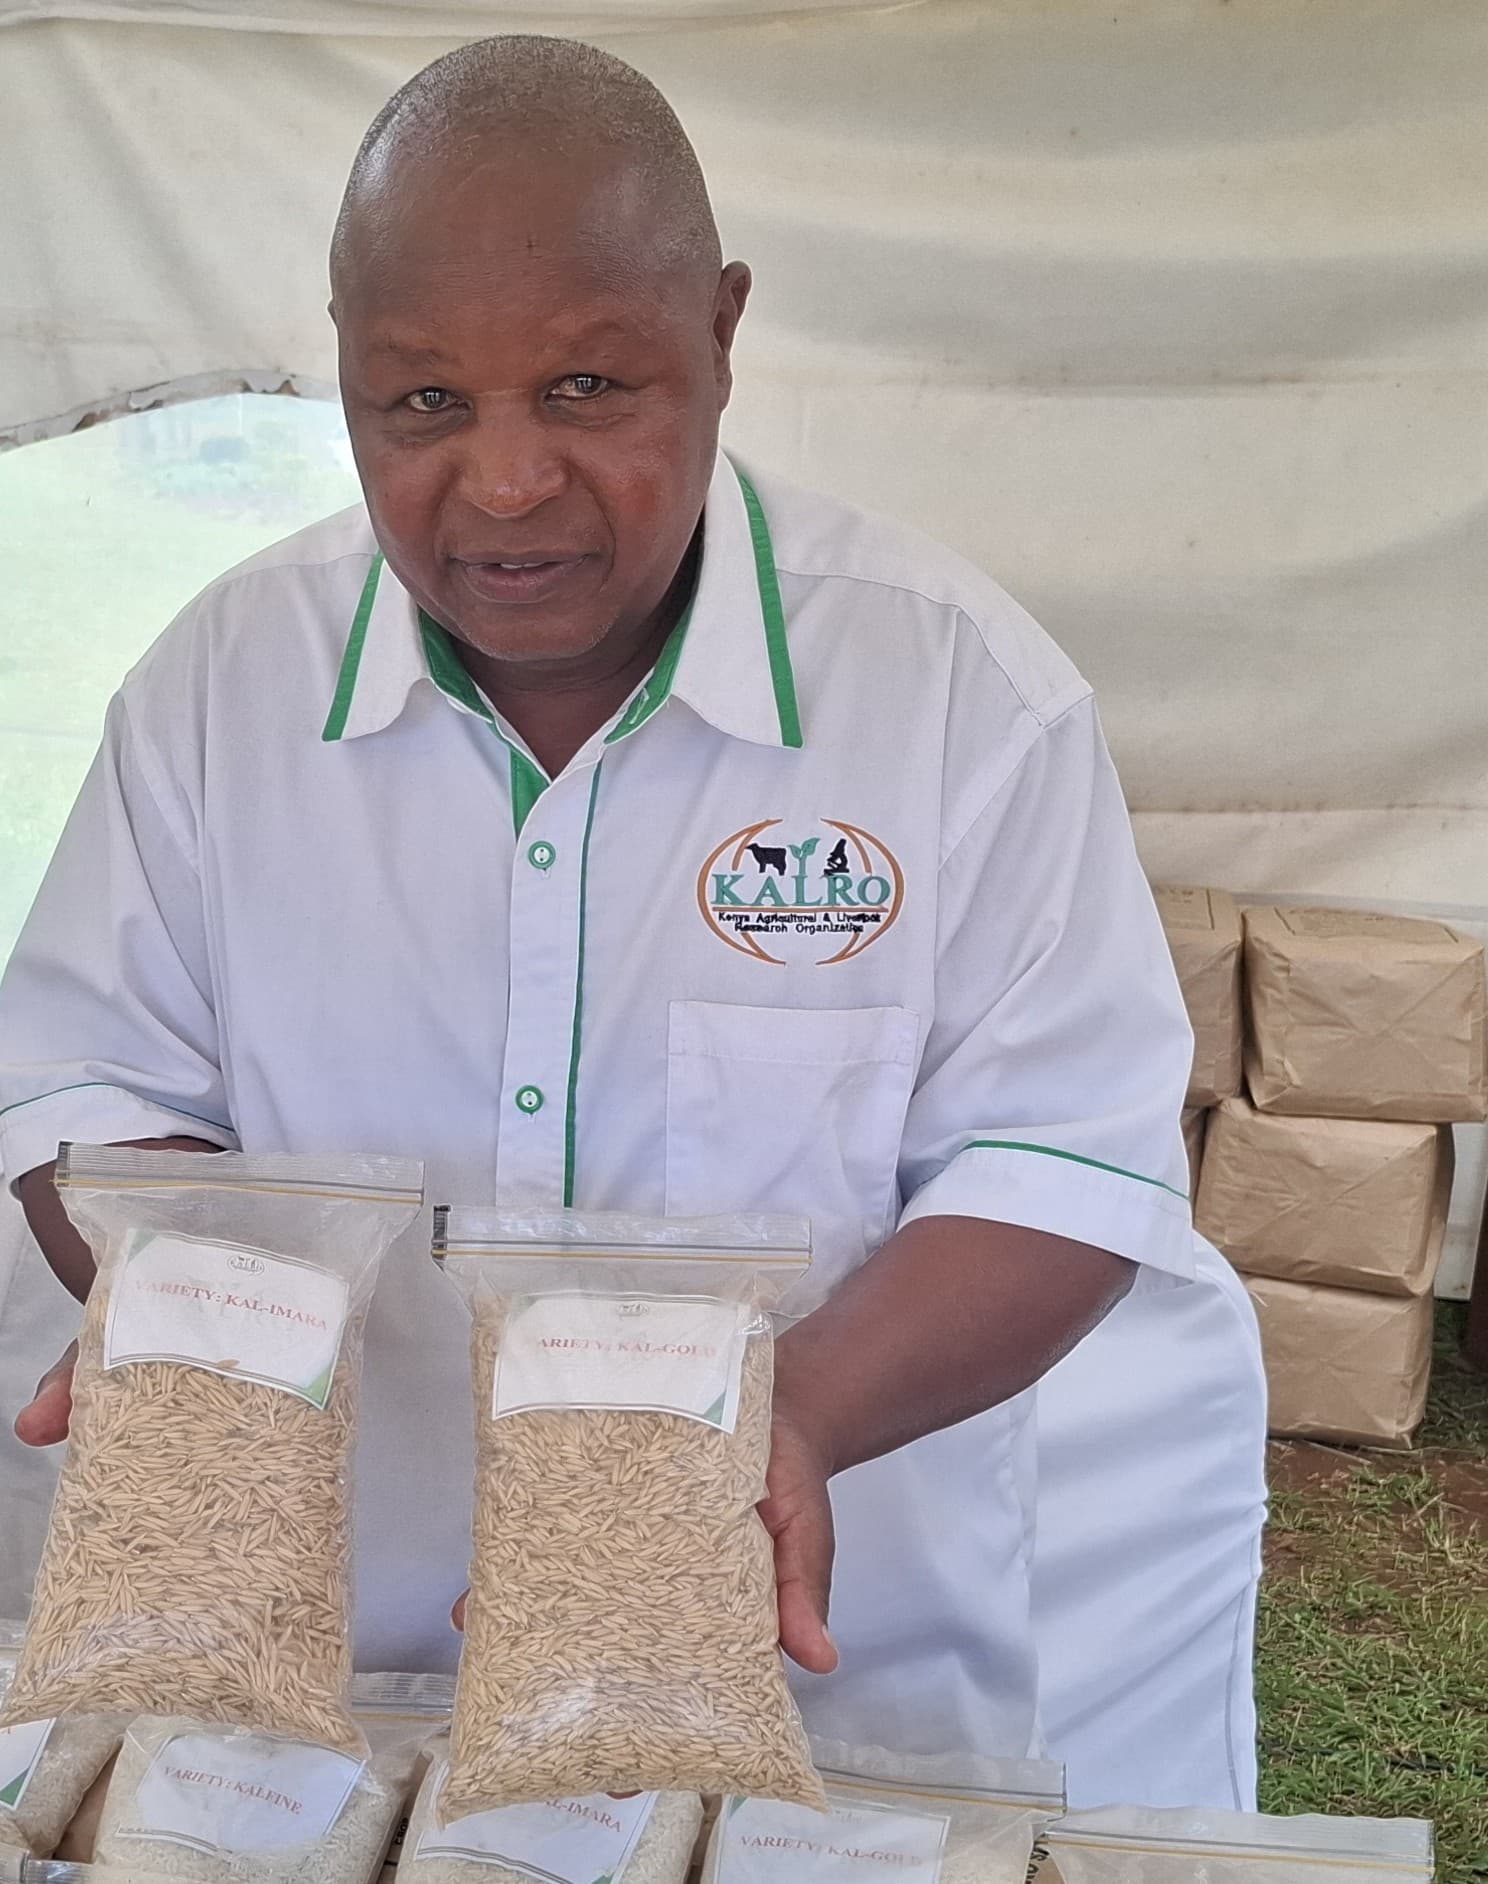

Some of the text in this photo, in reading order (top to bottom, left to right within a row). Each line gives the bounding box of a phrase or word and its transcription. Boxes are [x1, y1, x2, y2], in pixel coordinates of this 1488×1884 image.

[710, 874, 891, 907] KALRO
[718, 912, 750, 924] Kenya
[136, 1280, 328, 1331] VARIETY: KAL-IMARA
[538, 1338, 611, 1352] ARIETY:
[544, 1799, 622, 1833] L-IMARA
